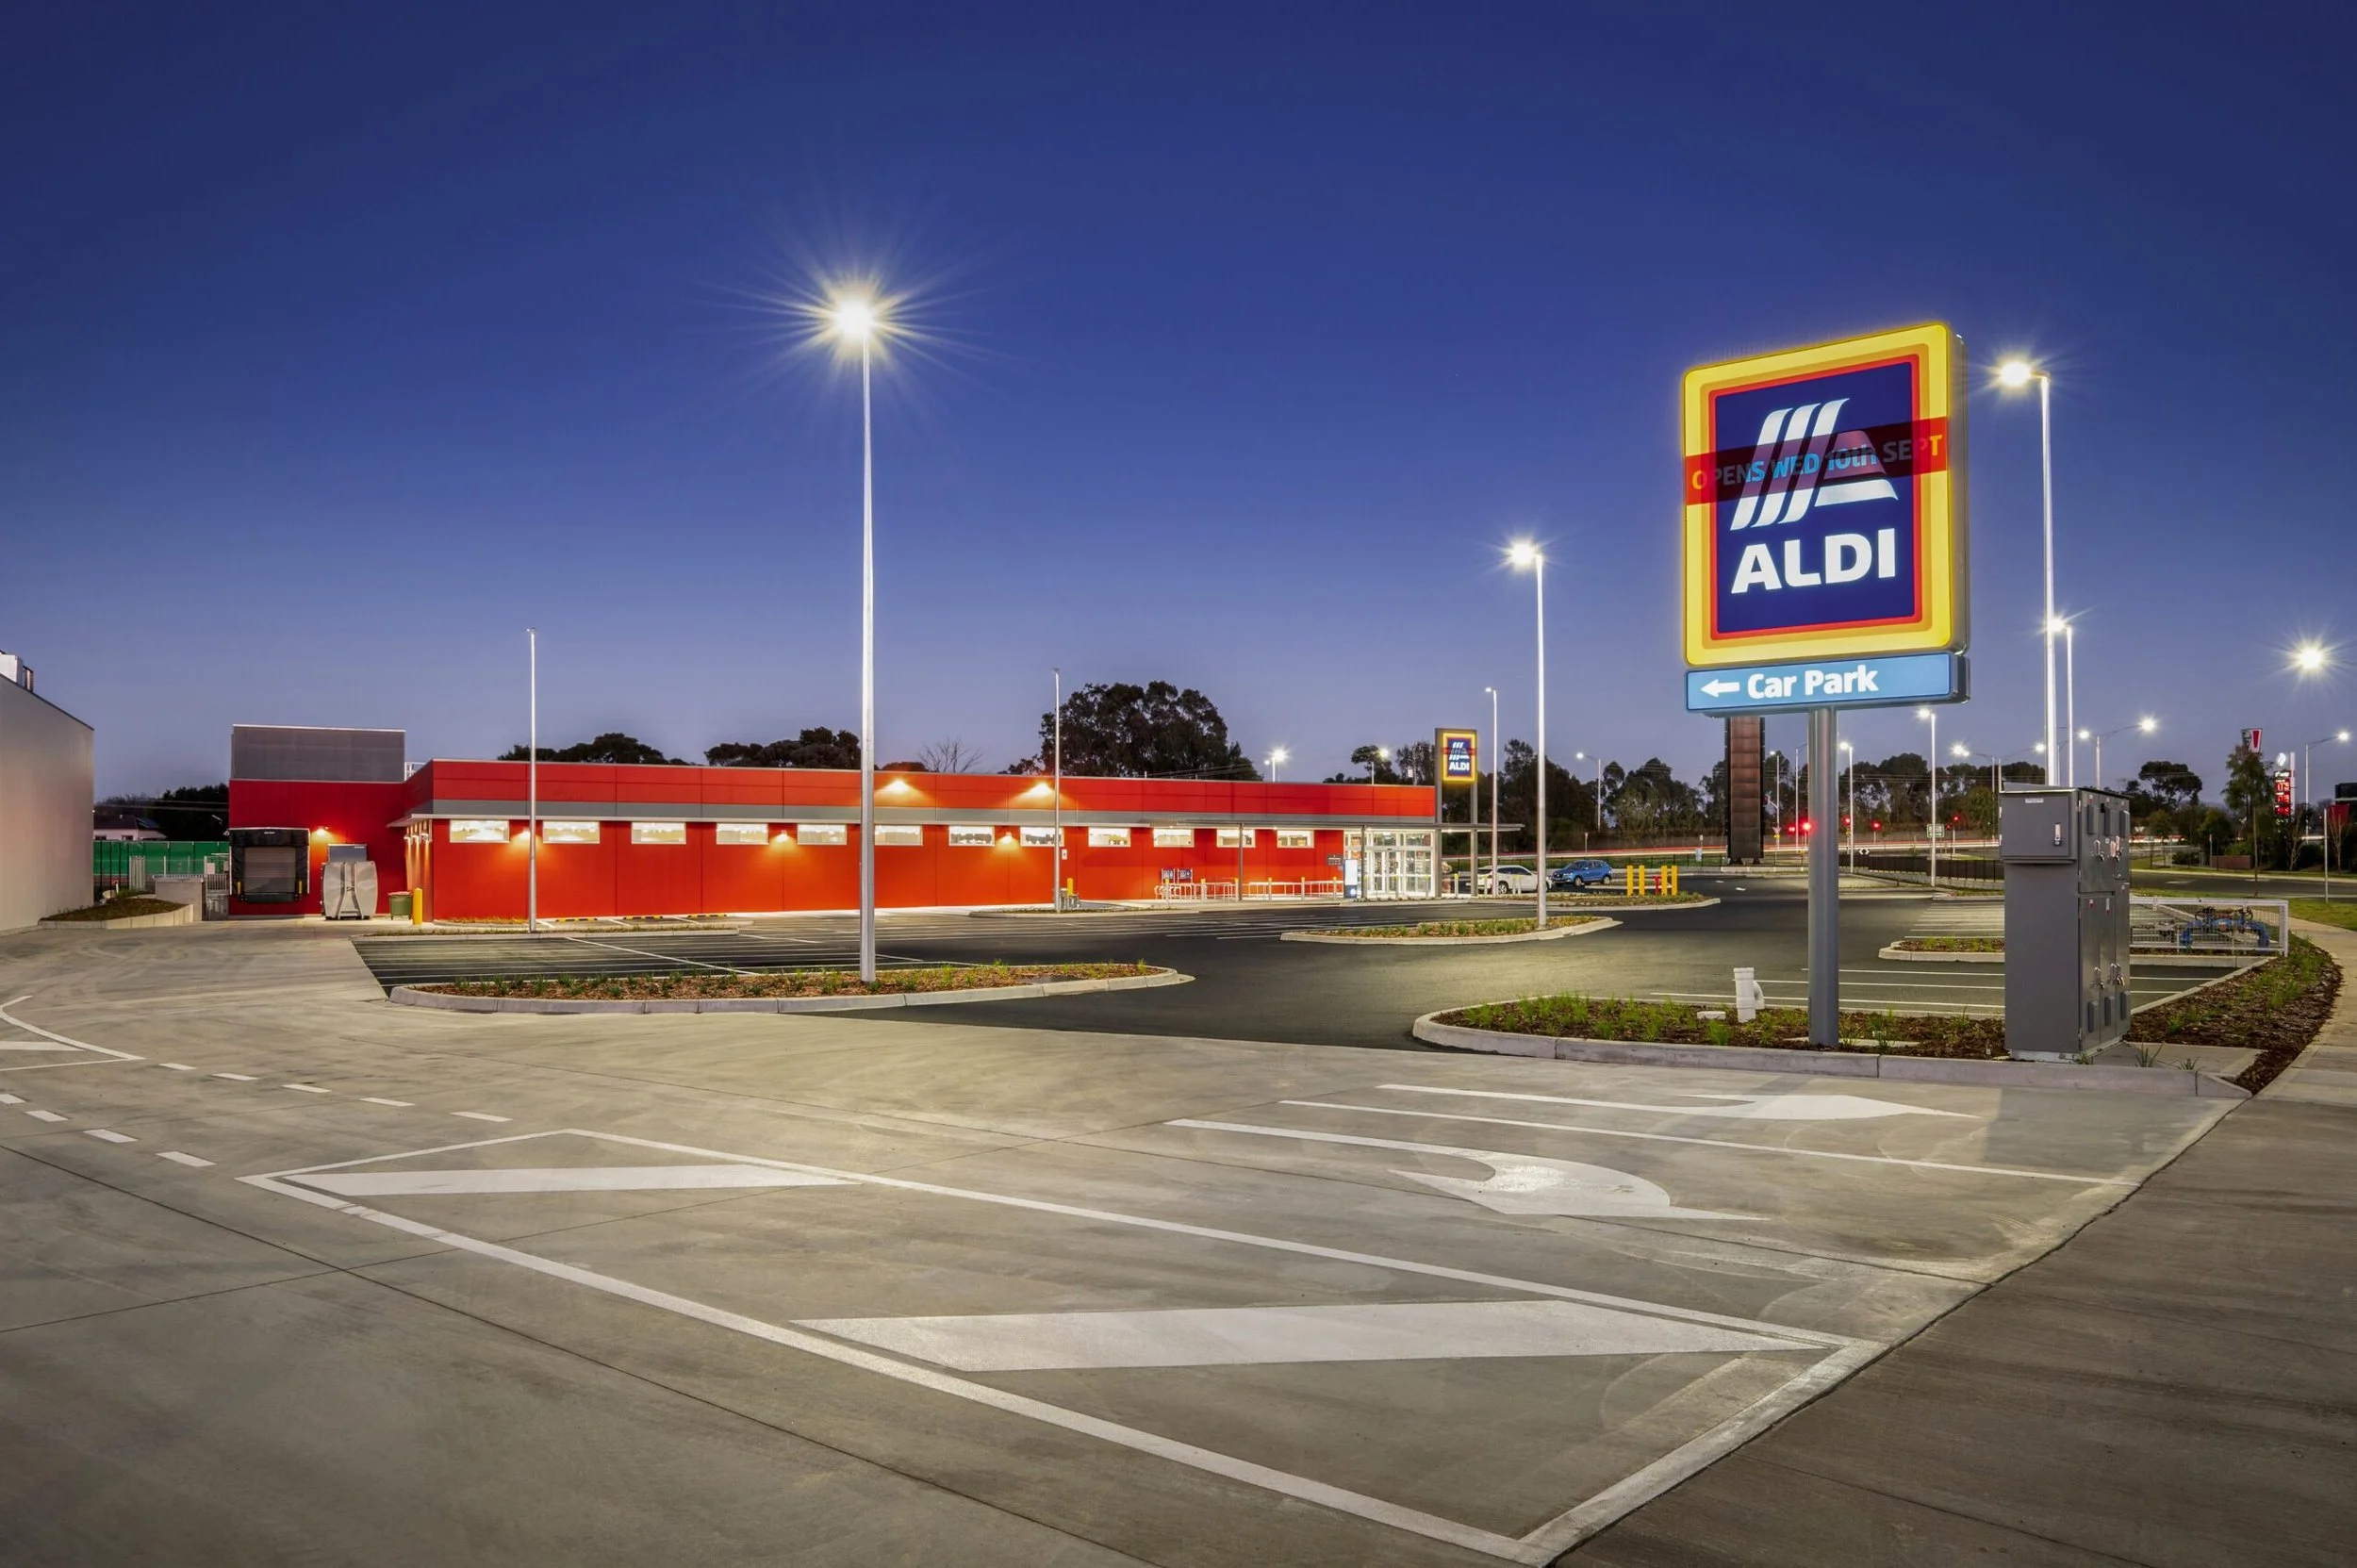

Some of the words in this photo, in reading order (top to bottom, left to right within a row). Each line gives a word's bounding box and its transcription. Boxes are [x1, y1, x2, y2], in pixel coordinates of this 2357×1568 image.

[1771, 453, 1820, 479] WED
[1731, 528, 1896, 594] ALDI
[1747, 673, 1797, 700] Car
[1805, 664, 1879, 696] Park
[1448, 762, 1470, 770] ALDI
